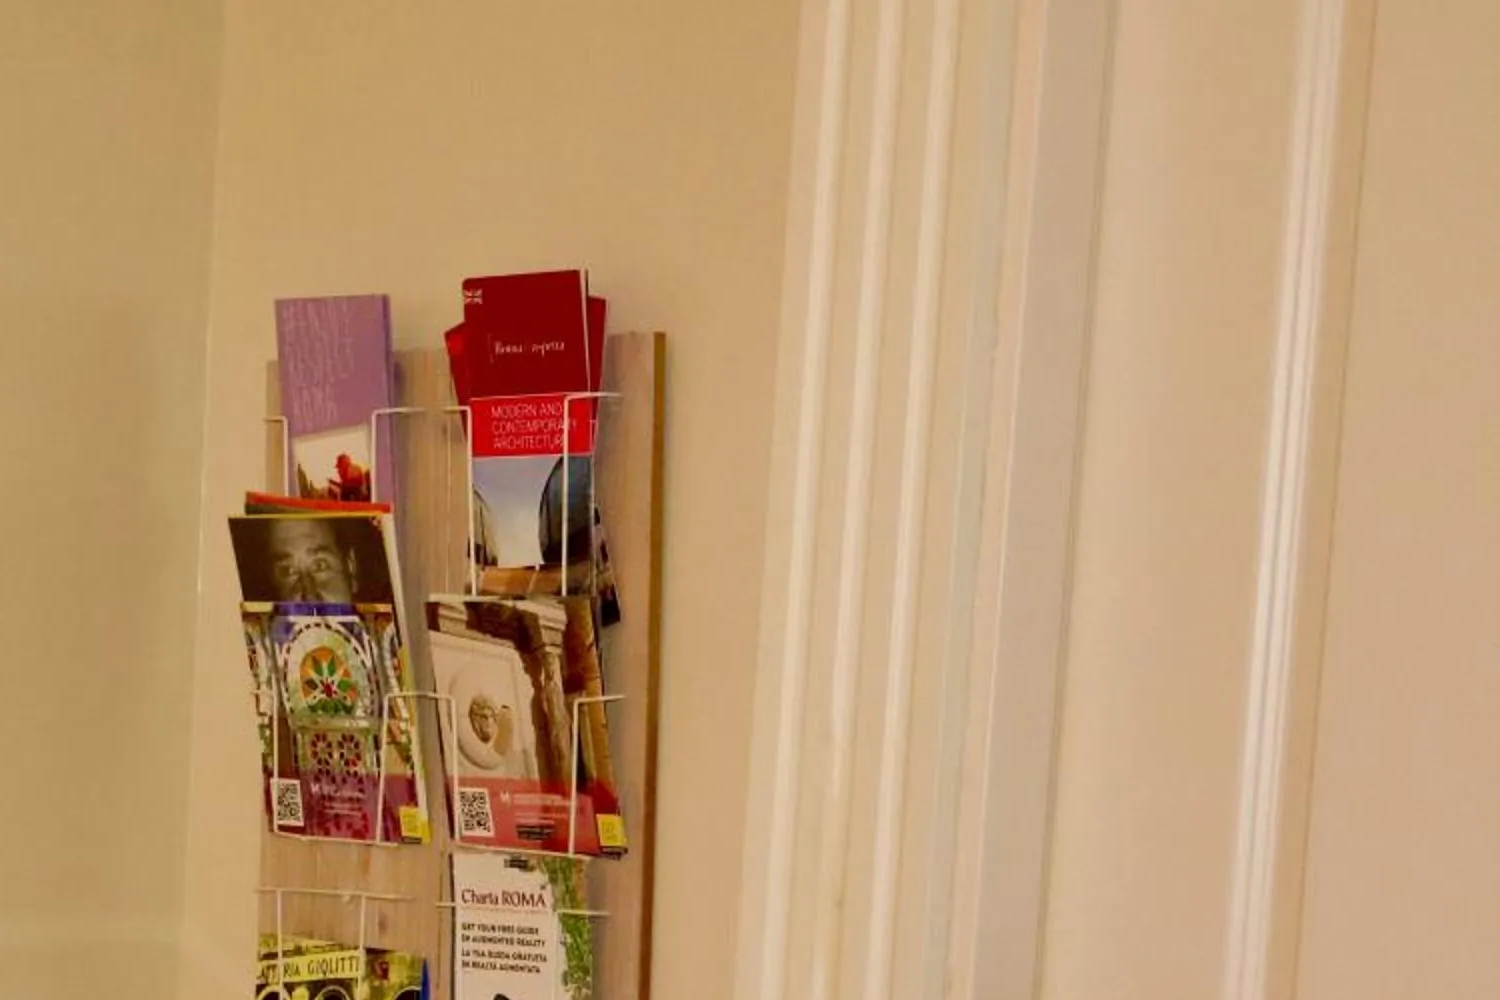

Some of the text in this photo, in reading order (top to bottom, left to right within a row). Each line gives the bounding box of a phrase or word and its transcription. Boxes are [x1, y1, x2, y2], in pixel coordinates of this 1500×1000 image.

[491, 402, 563, 418] MODERN AND
[501, 890, 547, 908] ROMA
